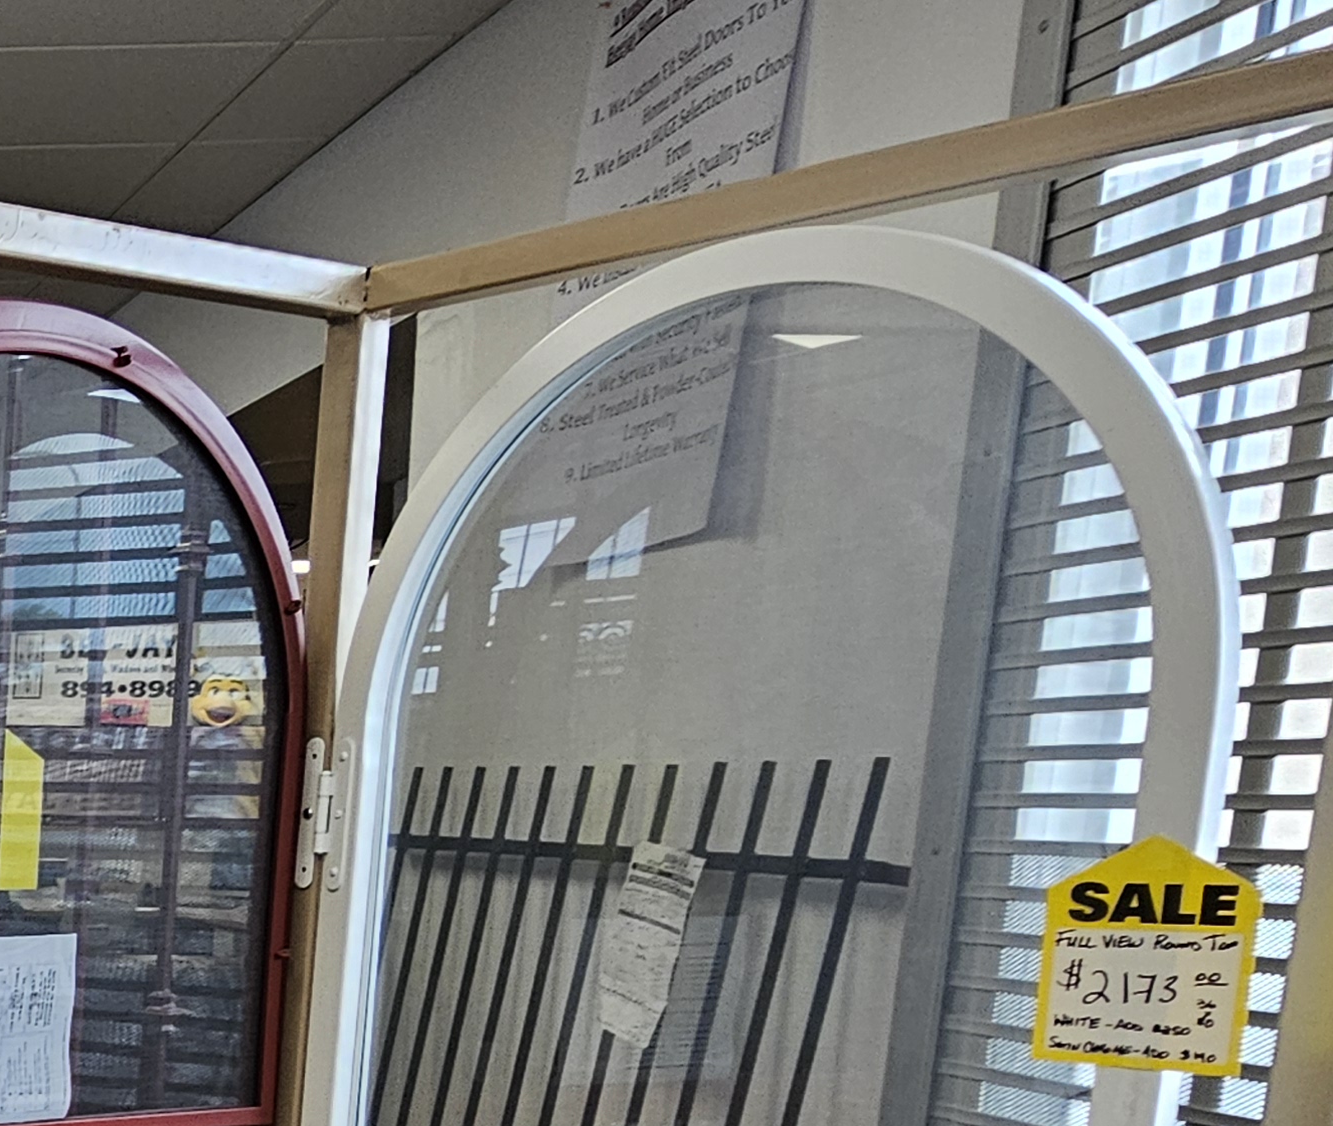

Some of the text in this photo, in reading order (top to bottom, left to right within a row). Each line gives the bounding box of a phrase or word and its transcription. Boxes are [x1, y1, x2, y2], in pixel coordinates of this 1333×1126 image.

[703, 15, 744, 51] Doors
[745, 2, 767, 26] To
[684, 51, 734, 97] Business
[573, 167, 590, 186] 2.
[593, 157, 615, 178] We
[679, 84, 734, 131] Selection
[734, 74, 752, 95] to
[698, 140, 743, 178] Quality
[557, 281, 572, 296] 4.
[558, 404, 596, 431] Steel
[579, 452, 623, 482] Limited
[1068, 881, 1240, 927] SALE
[1055, 929, 1097, 949] FULL
[1102, 934, 1144, 949] VIEW
[1056, 958, 1179, 1005] $2173
[1053, 1013, 1102, 1030] WHITE
